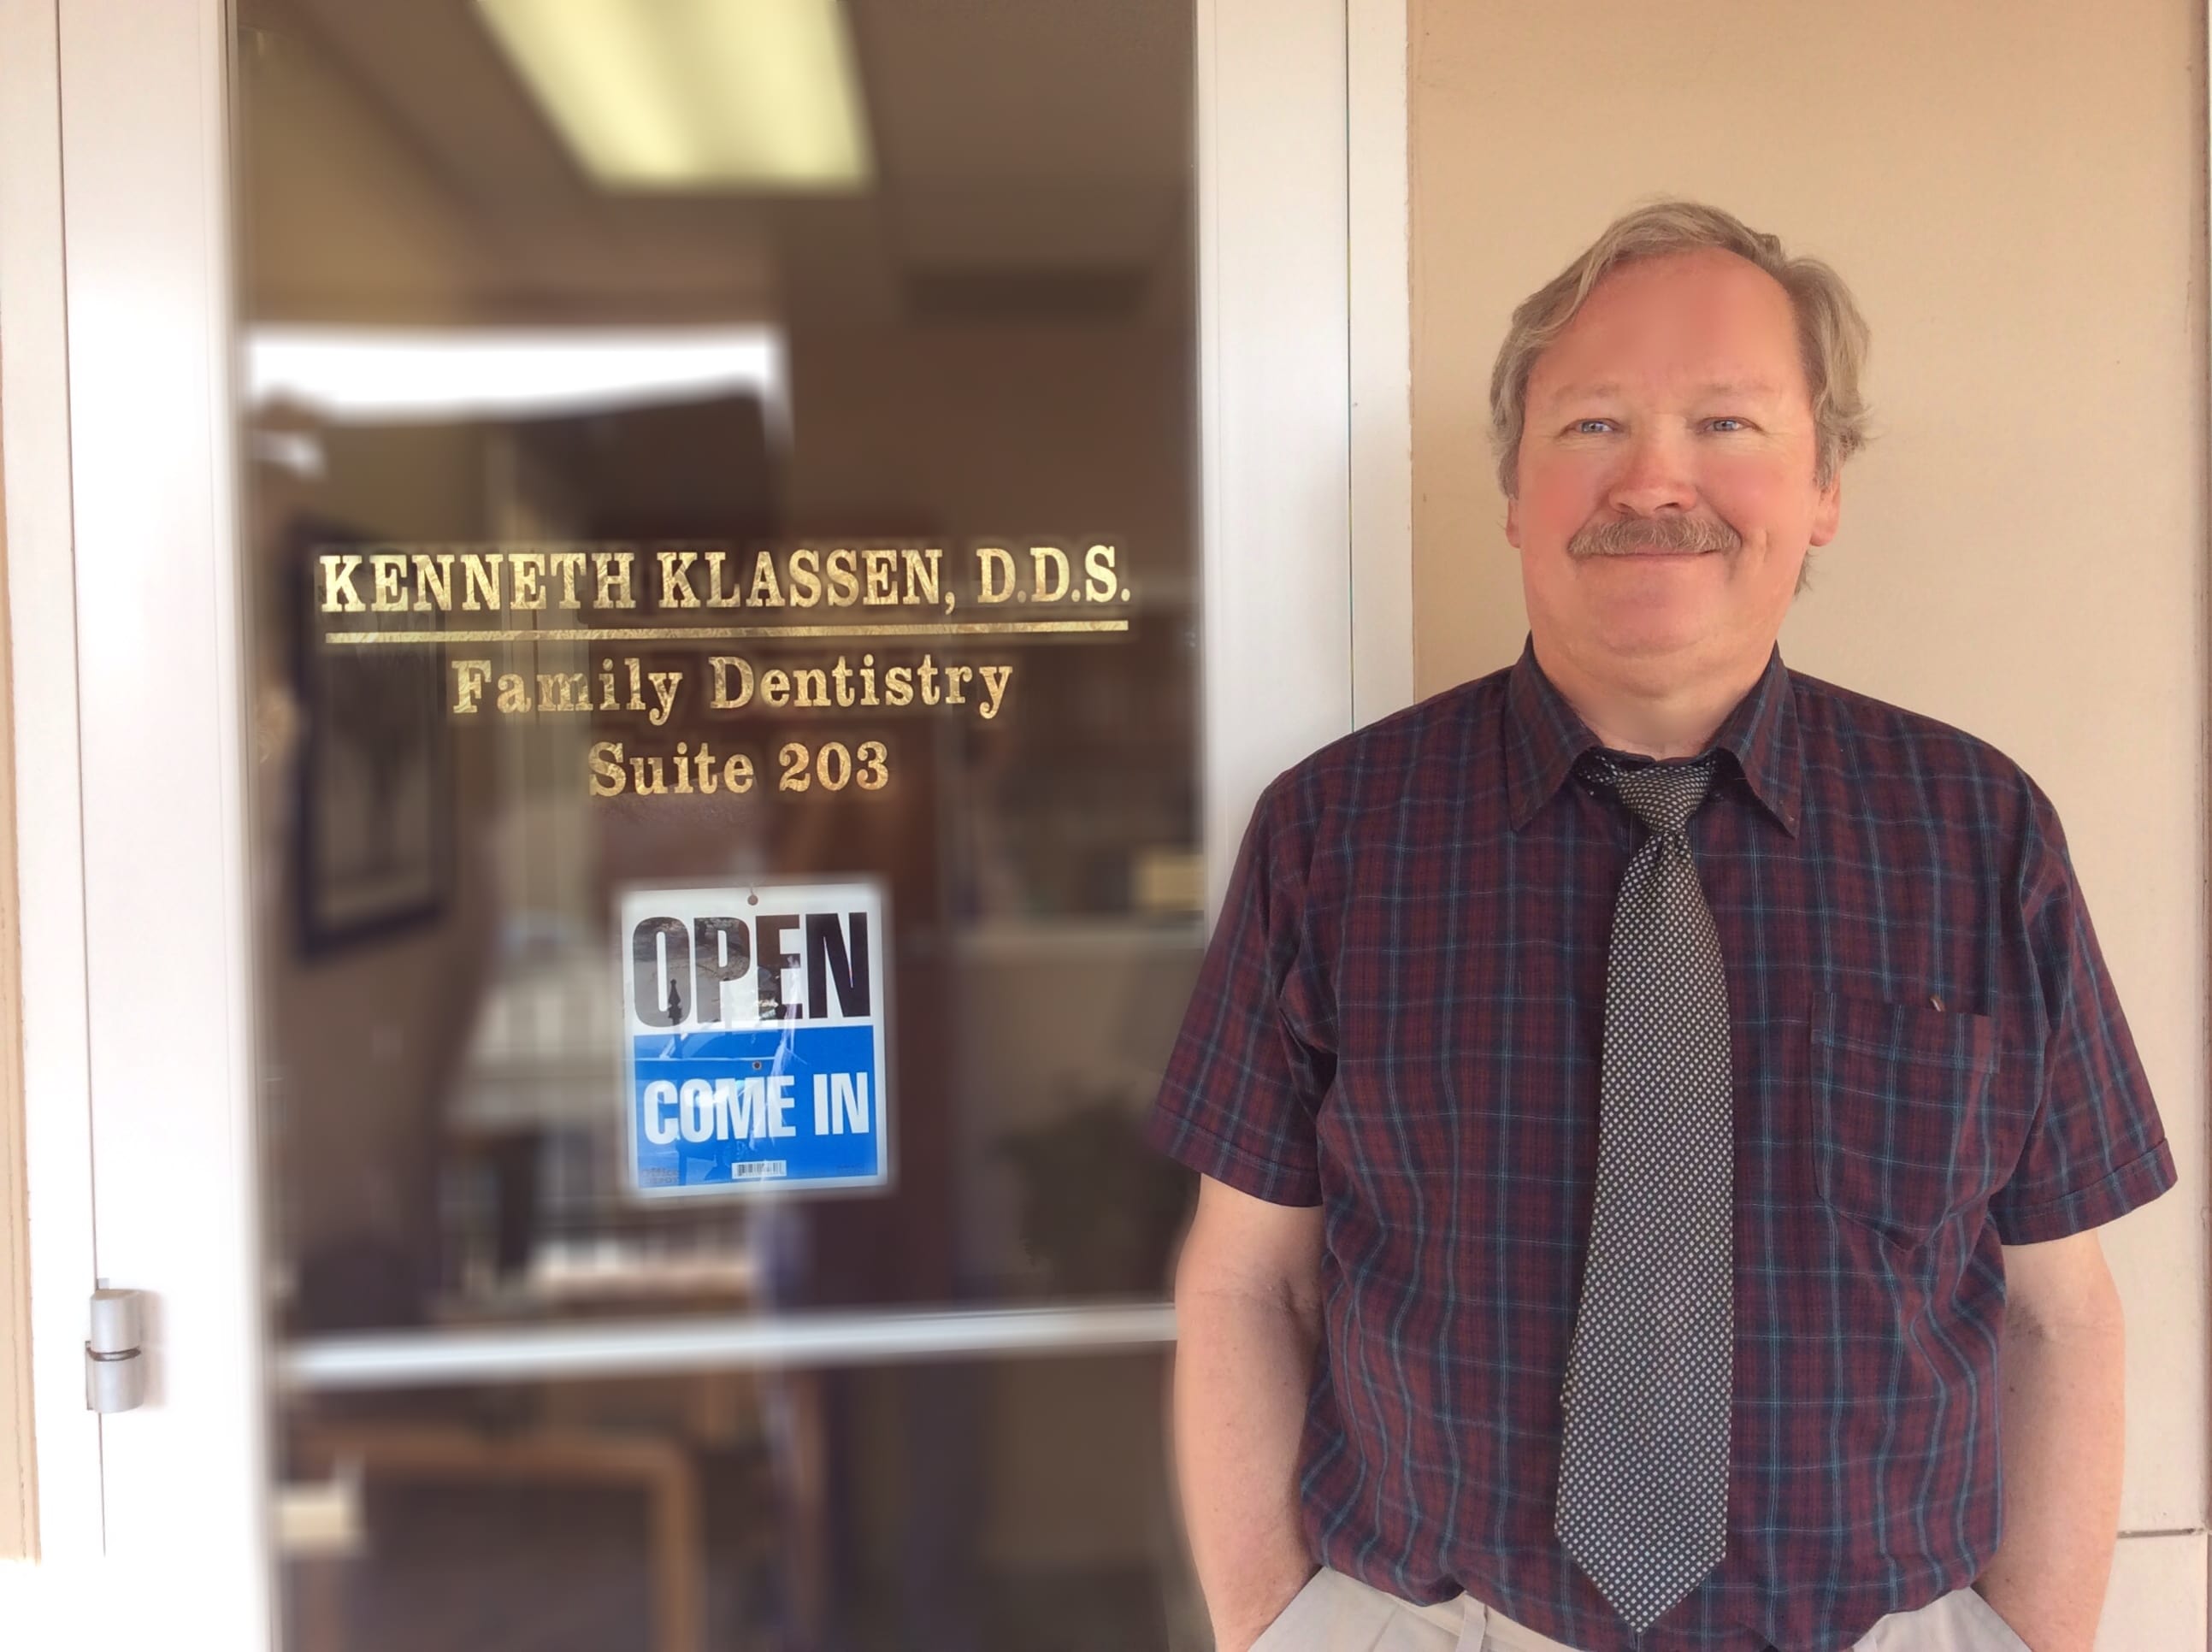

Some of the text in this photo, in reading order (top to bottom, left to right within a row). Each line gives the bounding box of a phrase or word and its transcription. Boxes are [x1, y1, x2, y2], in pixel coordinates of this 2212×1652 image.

[320, 545, 1130, 615] KENNETH KLASSEN, D.D.S.
[451, 653, 1013, 725] Family Dentistry
[588, 740, 889, 797] Suite 203
[633, 912, 870, 1027] OPEN
[644, 1071, 870, 1145] COME IN
